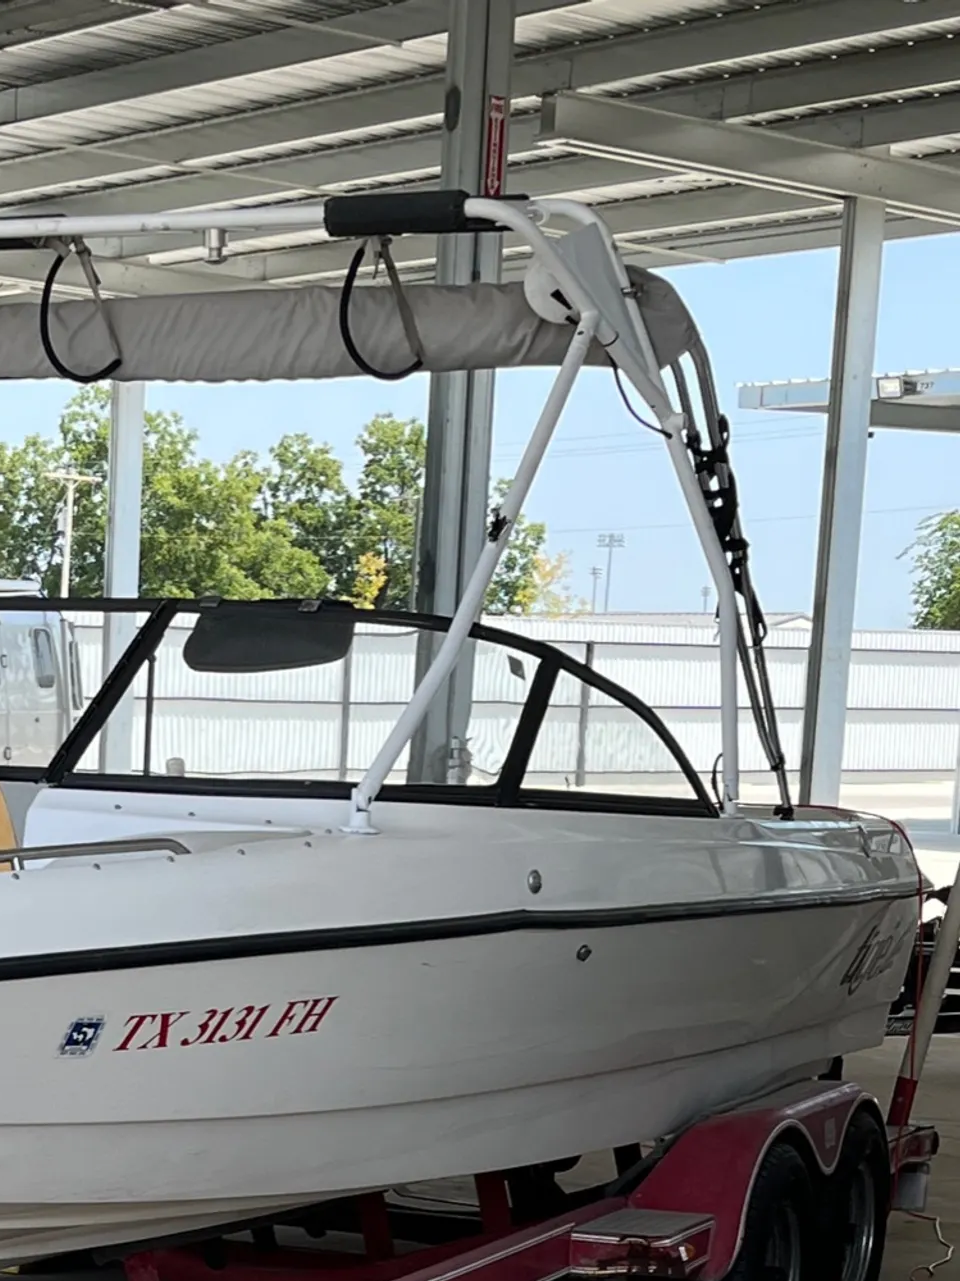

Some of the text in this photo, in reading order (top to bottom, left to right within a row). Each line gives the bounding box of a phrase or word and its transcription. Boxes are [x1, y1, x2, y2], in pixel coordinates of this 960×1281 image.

[112, 1011, 190, 1051] TX
[180, 1003, 271, 1047] 3131
[265, 995, 340, 1038] FH
